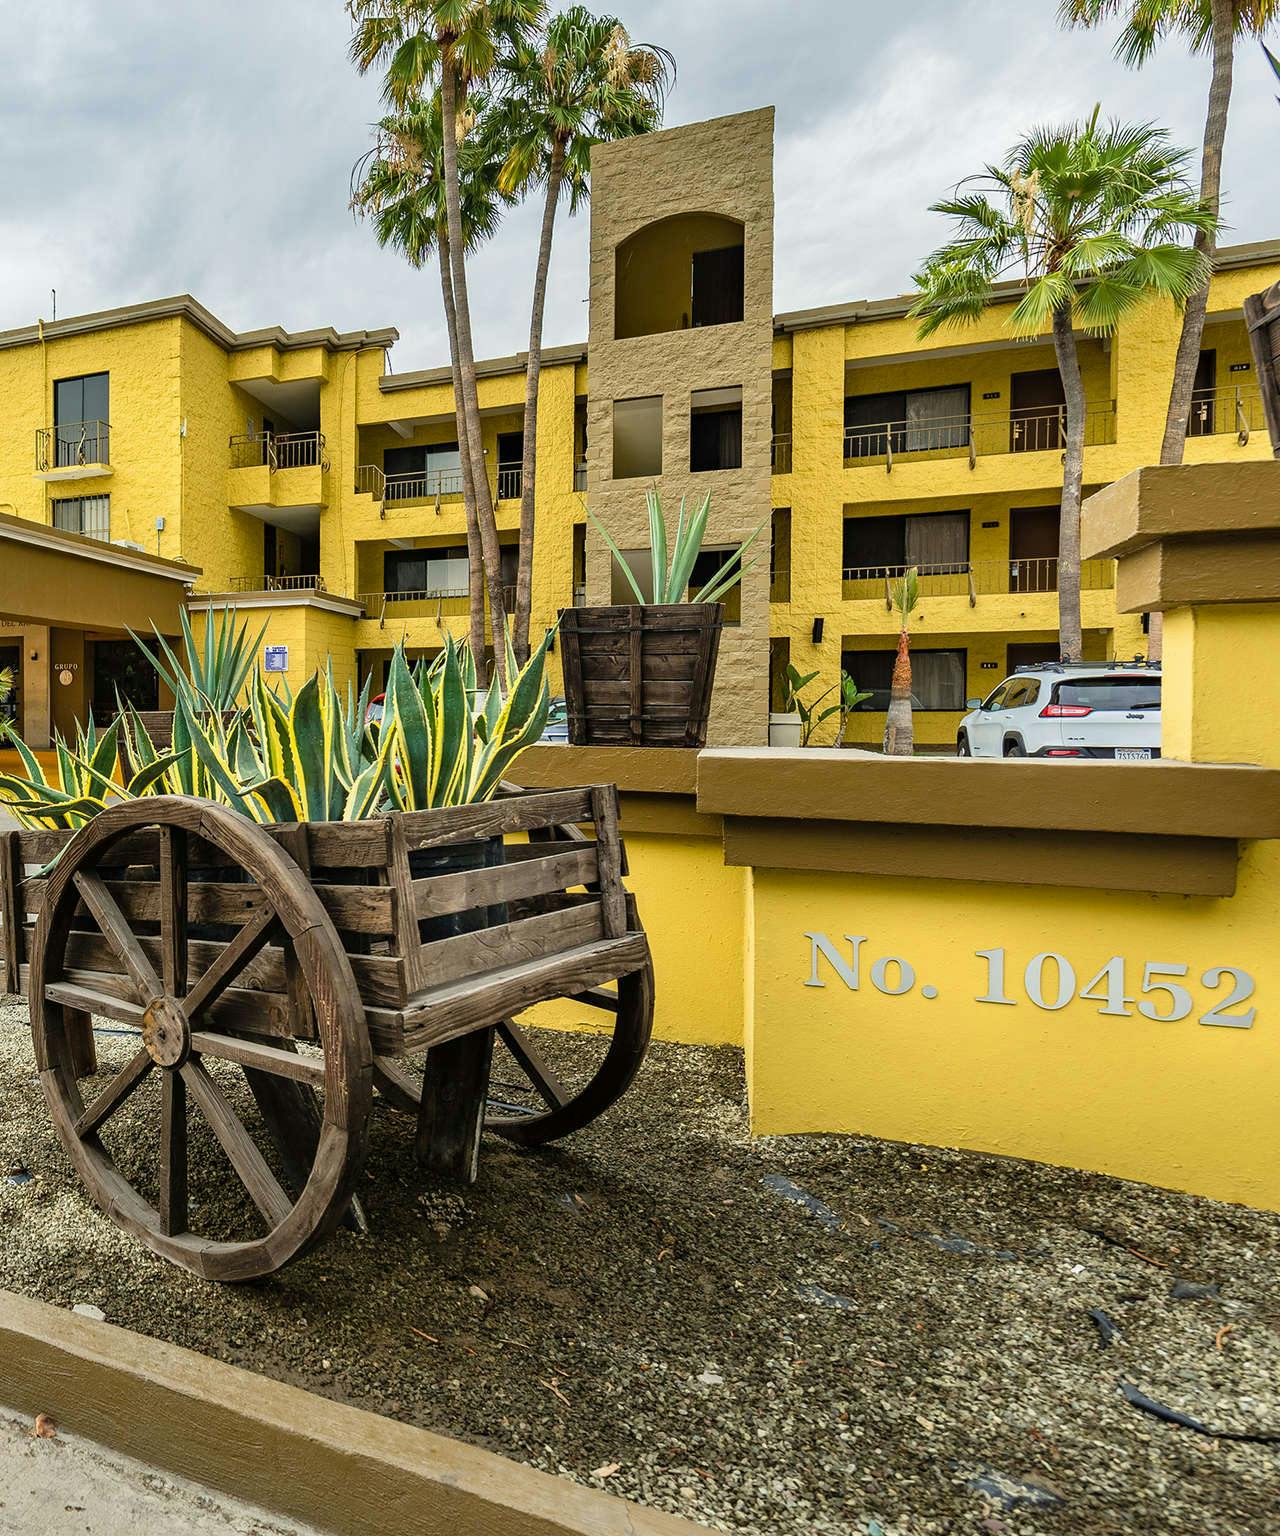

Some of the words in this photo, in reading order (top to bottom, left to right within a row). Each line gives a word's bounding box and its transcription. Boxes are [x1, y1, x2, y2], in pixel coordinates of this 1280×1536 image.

[54, 663, 78, 671] GRUPO
[803, 931, 938, 1000] No.
[975, 947, 1257, 1030] 10452
